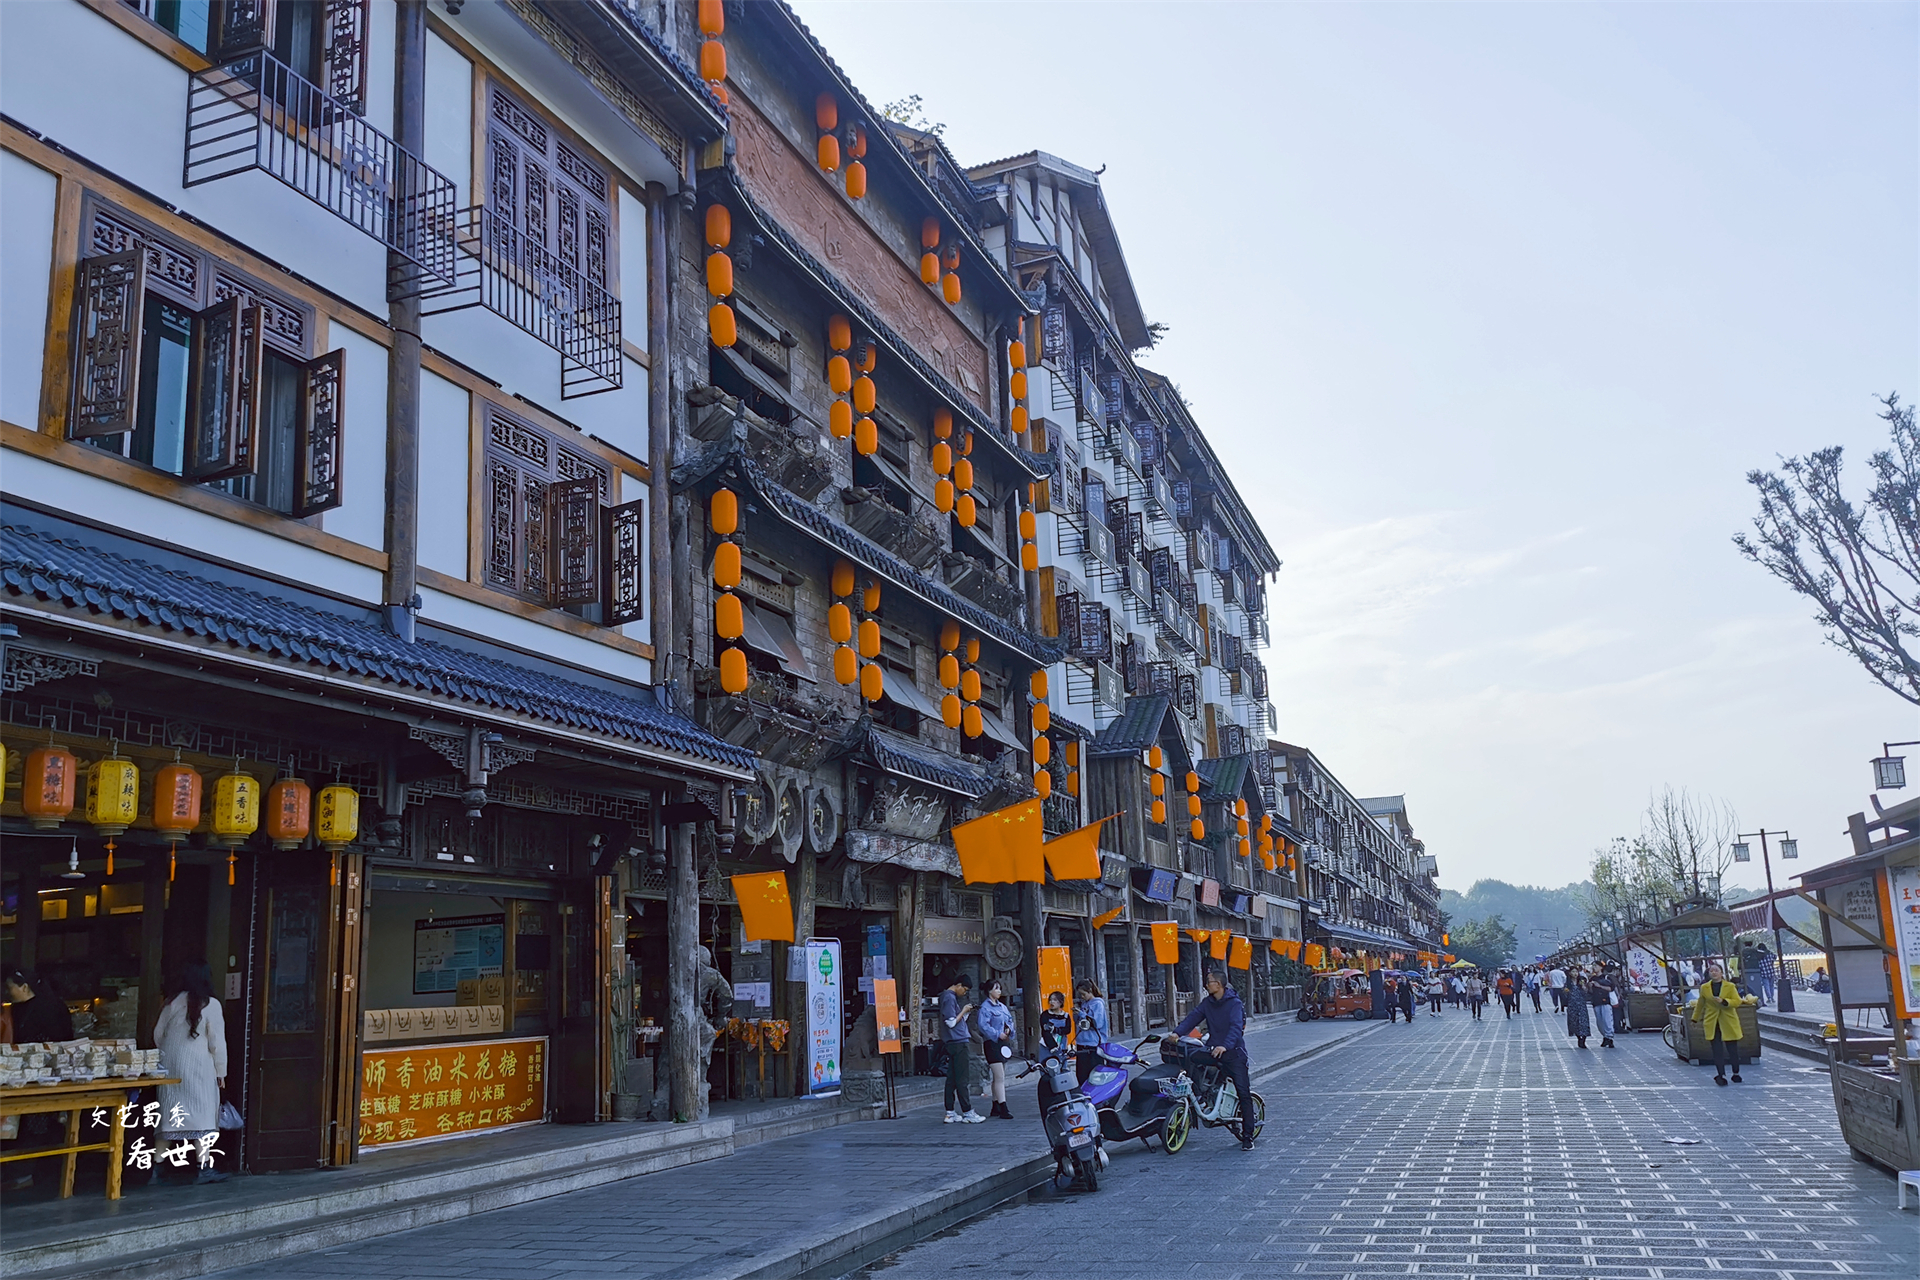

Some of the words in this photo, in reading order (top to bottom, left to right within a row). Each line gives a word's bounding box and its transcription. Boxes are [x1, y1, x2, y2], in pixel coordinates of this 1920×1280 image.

[121, 767, 136, 813] 麻辣味
[234, 782, 249, 824] 五香味
[366, 1049, 518, 1094] 师香油米花糖
[359, 1095, 401, 1118] 生酥糖
[408, 1088, 463, 1111] 芝麻酥糖
[469, 1083, 506, 1104] 小米酥
[436, 1104, 514, 1133] 各种口味
